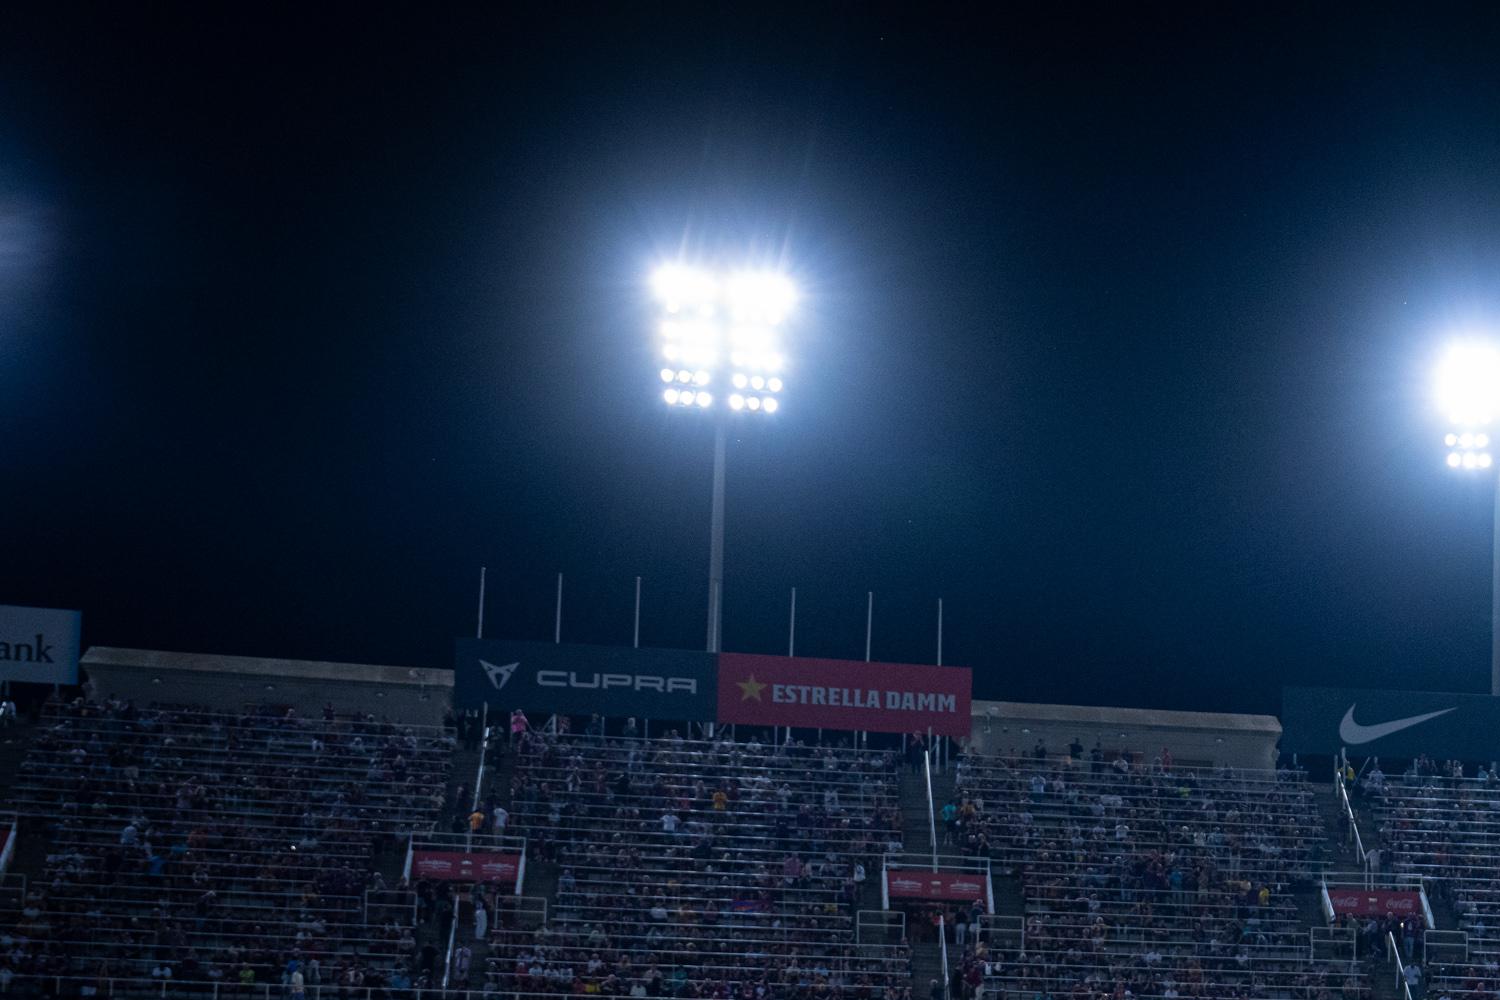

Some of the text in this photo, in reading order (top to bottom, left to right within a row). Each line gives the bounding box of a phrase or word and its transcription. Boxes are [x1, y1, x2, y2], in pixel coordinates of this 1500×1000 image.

[537, 670, 697, 694] CUPRA
[772, 684, 956, 713] ESTRELLA DAMM
